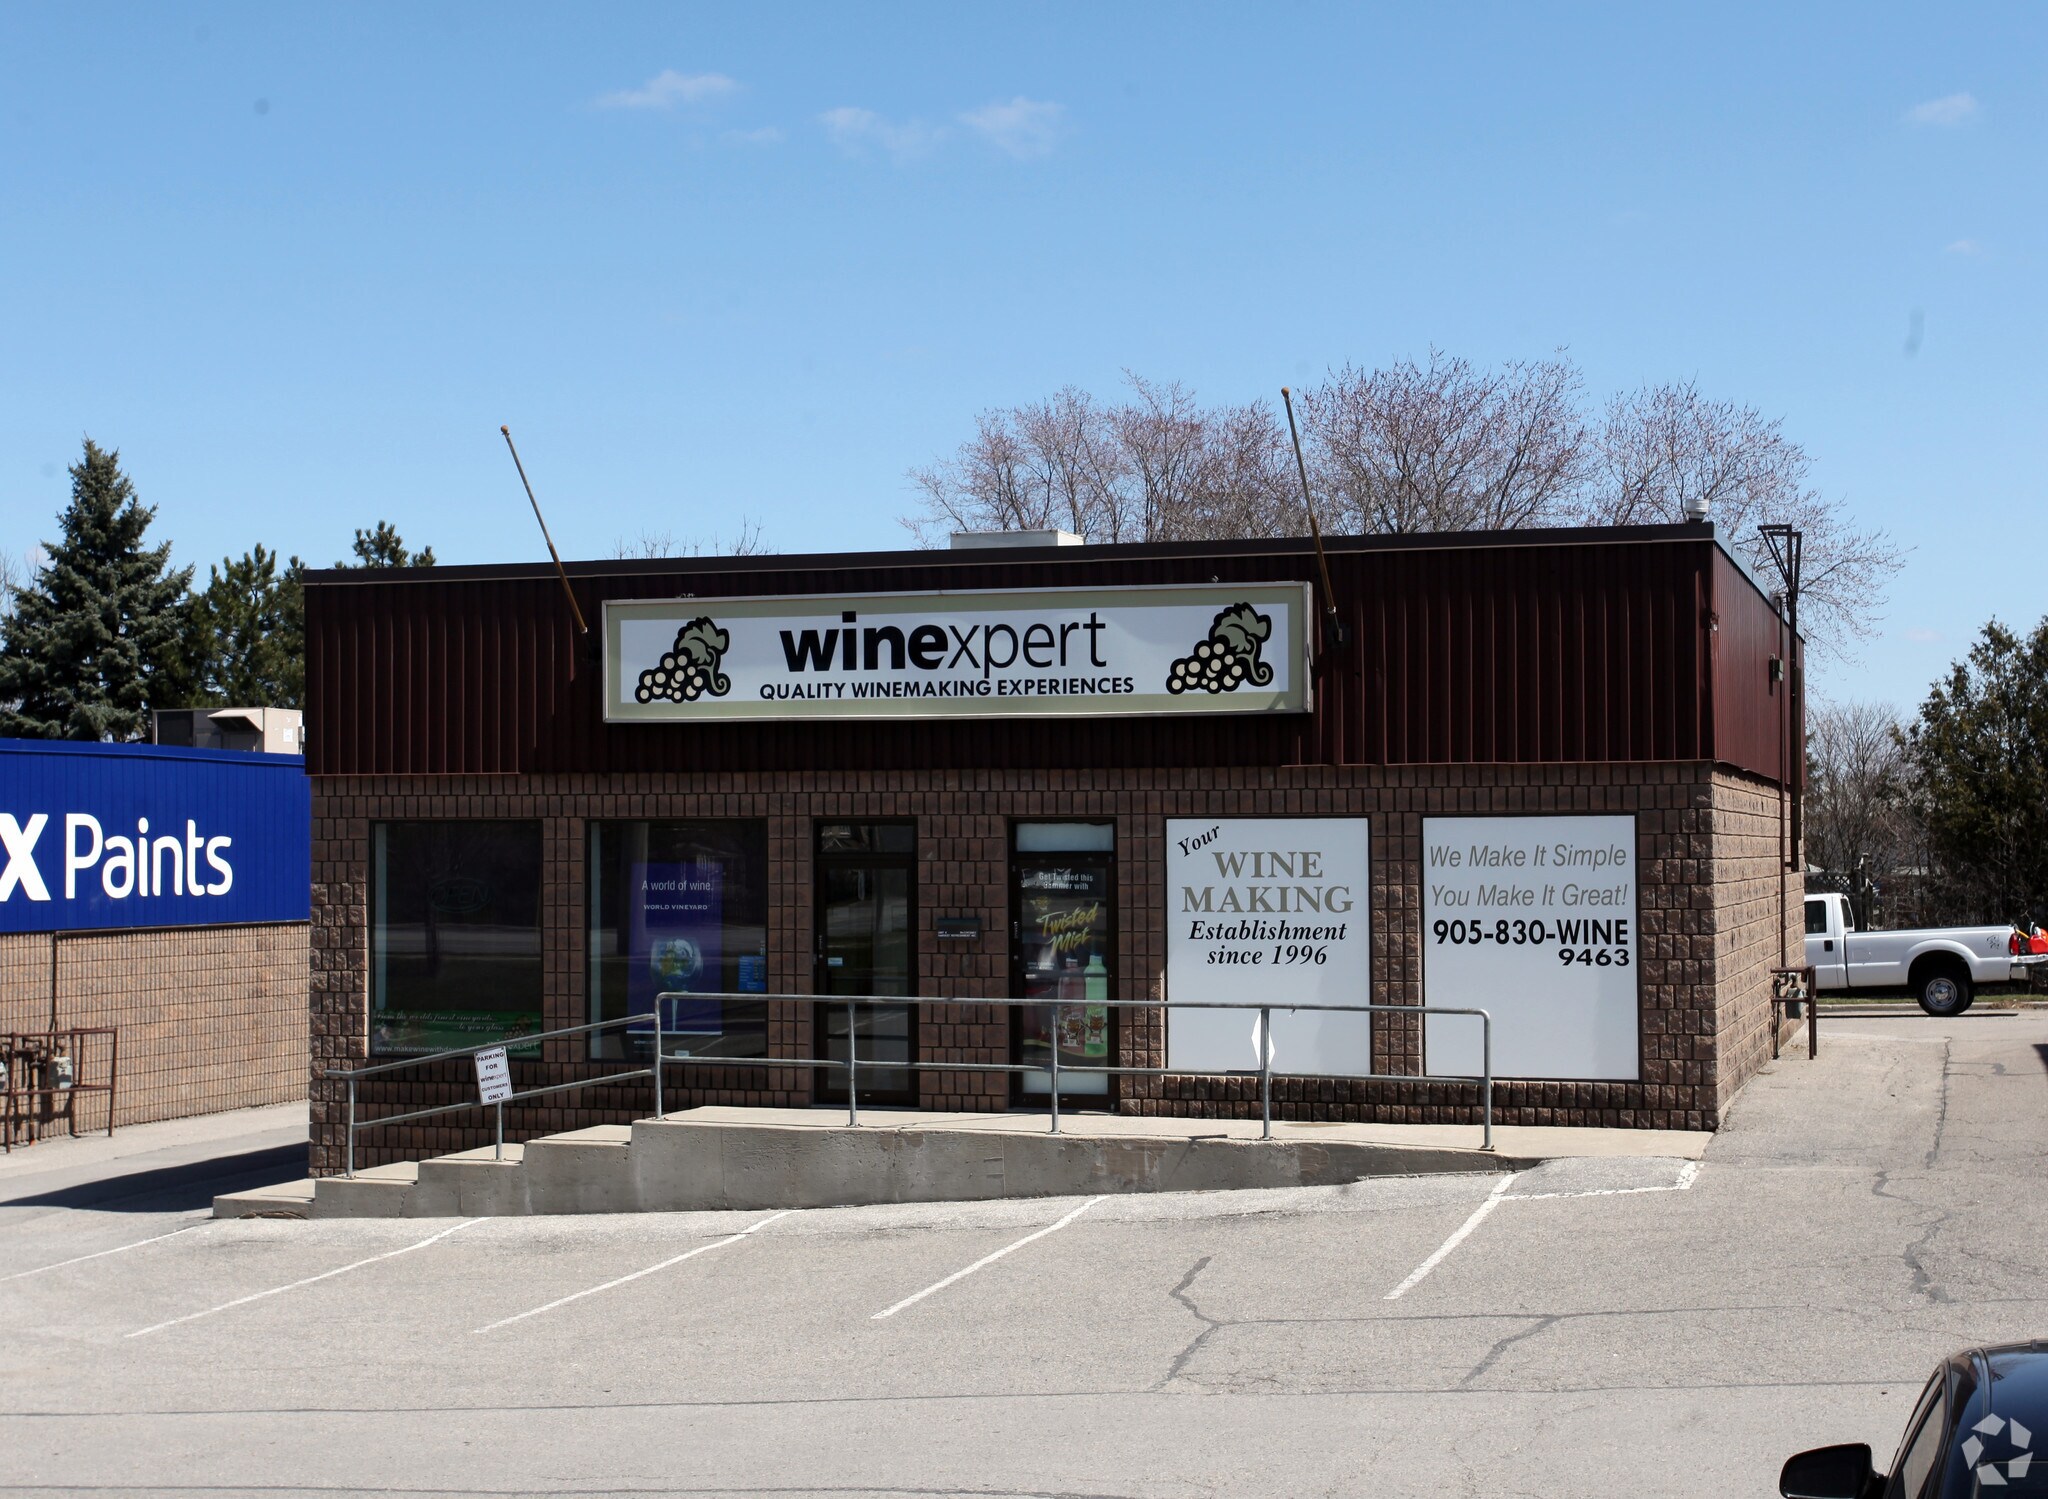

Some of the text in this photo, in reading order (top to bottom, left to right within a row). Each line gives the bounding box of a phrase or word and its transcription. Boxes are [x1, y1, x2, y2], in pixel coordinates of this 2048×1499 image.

[779, 610, 1107, 678] winexpert
[759, 676, 1134, 700] QUALITY WINEMAKING EXPERIENCES
[1178, 825, 1220, 857] Your
[65, 813, 233, 899] Paints
[1212, 851, 1323, 878] WINE
[1430, 844, 1626, 872] We Make It Simple
[641, 880, 648, 891] A
[650, 880, 675, 891] world
[678, 880, 687, 891] of
[1432, 883, 1628, 907] You Make It Great!
[1181, 886, 1354, 914] MAKING
[1035, 901, 1099, 937] Twisted
[1188, 920, 1347, 940] Establishment
[1045, 926, 1092, 955] Mist
[1433, 919, 1628, 945] 905-830-WINE
[1207, 945, 1328, 966] since 1996
[1558, 948, 1630, 967] 9463
[477, 1051, 504, 1062] PARKING
[485, 1063, 498, 1071] FOR
[481, 1082, 508, 1092] CUSTOMERS
[488, 1092, 504, 1100] ONLY
